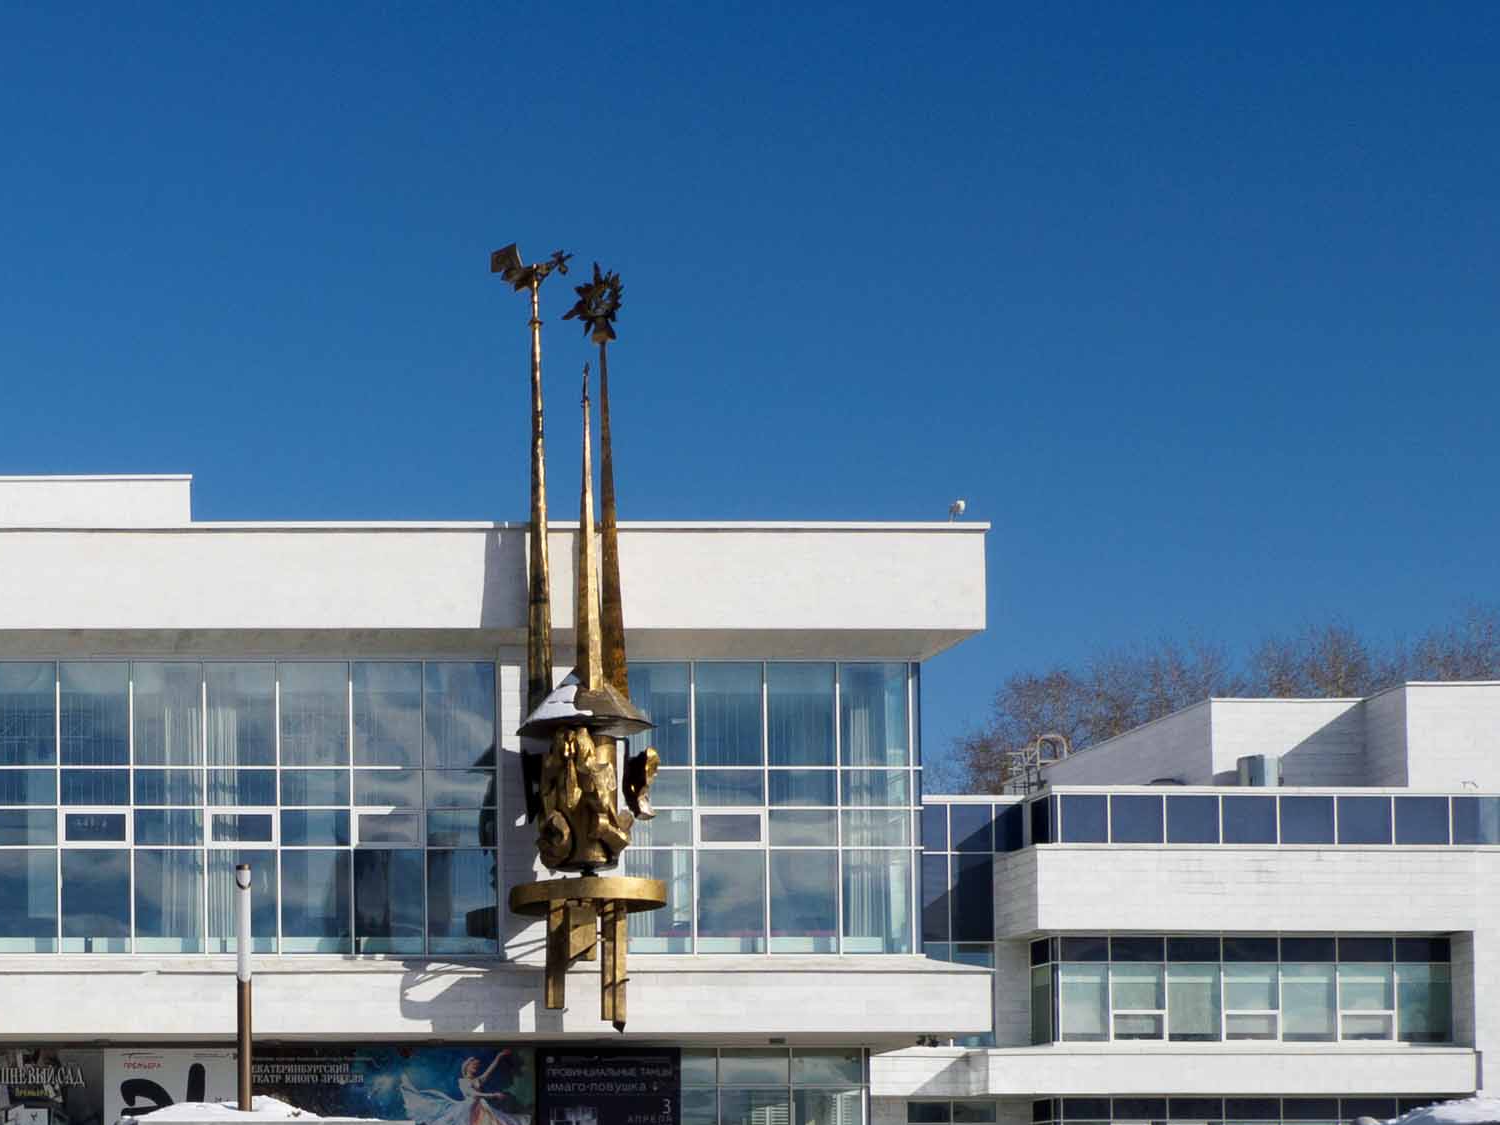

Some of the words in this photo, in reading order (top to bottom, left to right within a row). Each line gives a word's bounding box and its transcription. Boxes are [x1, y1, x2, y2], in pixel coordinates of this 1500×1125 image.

[57, 1065, 85, 1087] САД
[252, 1074, 281, 1084] ТЕАТР
[284, 1073, 319, 1084] ЮНОГО
